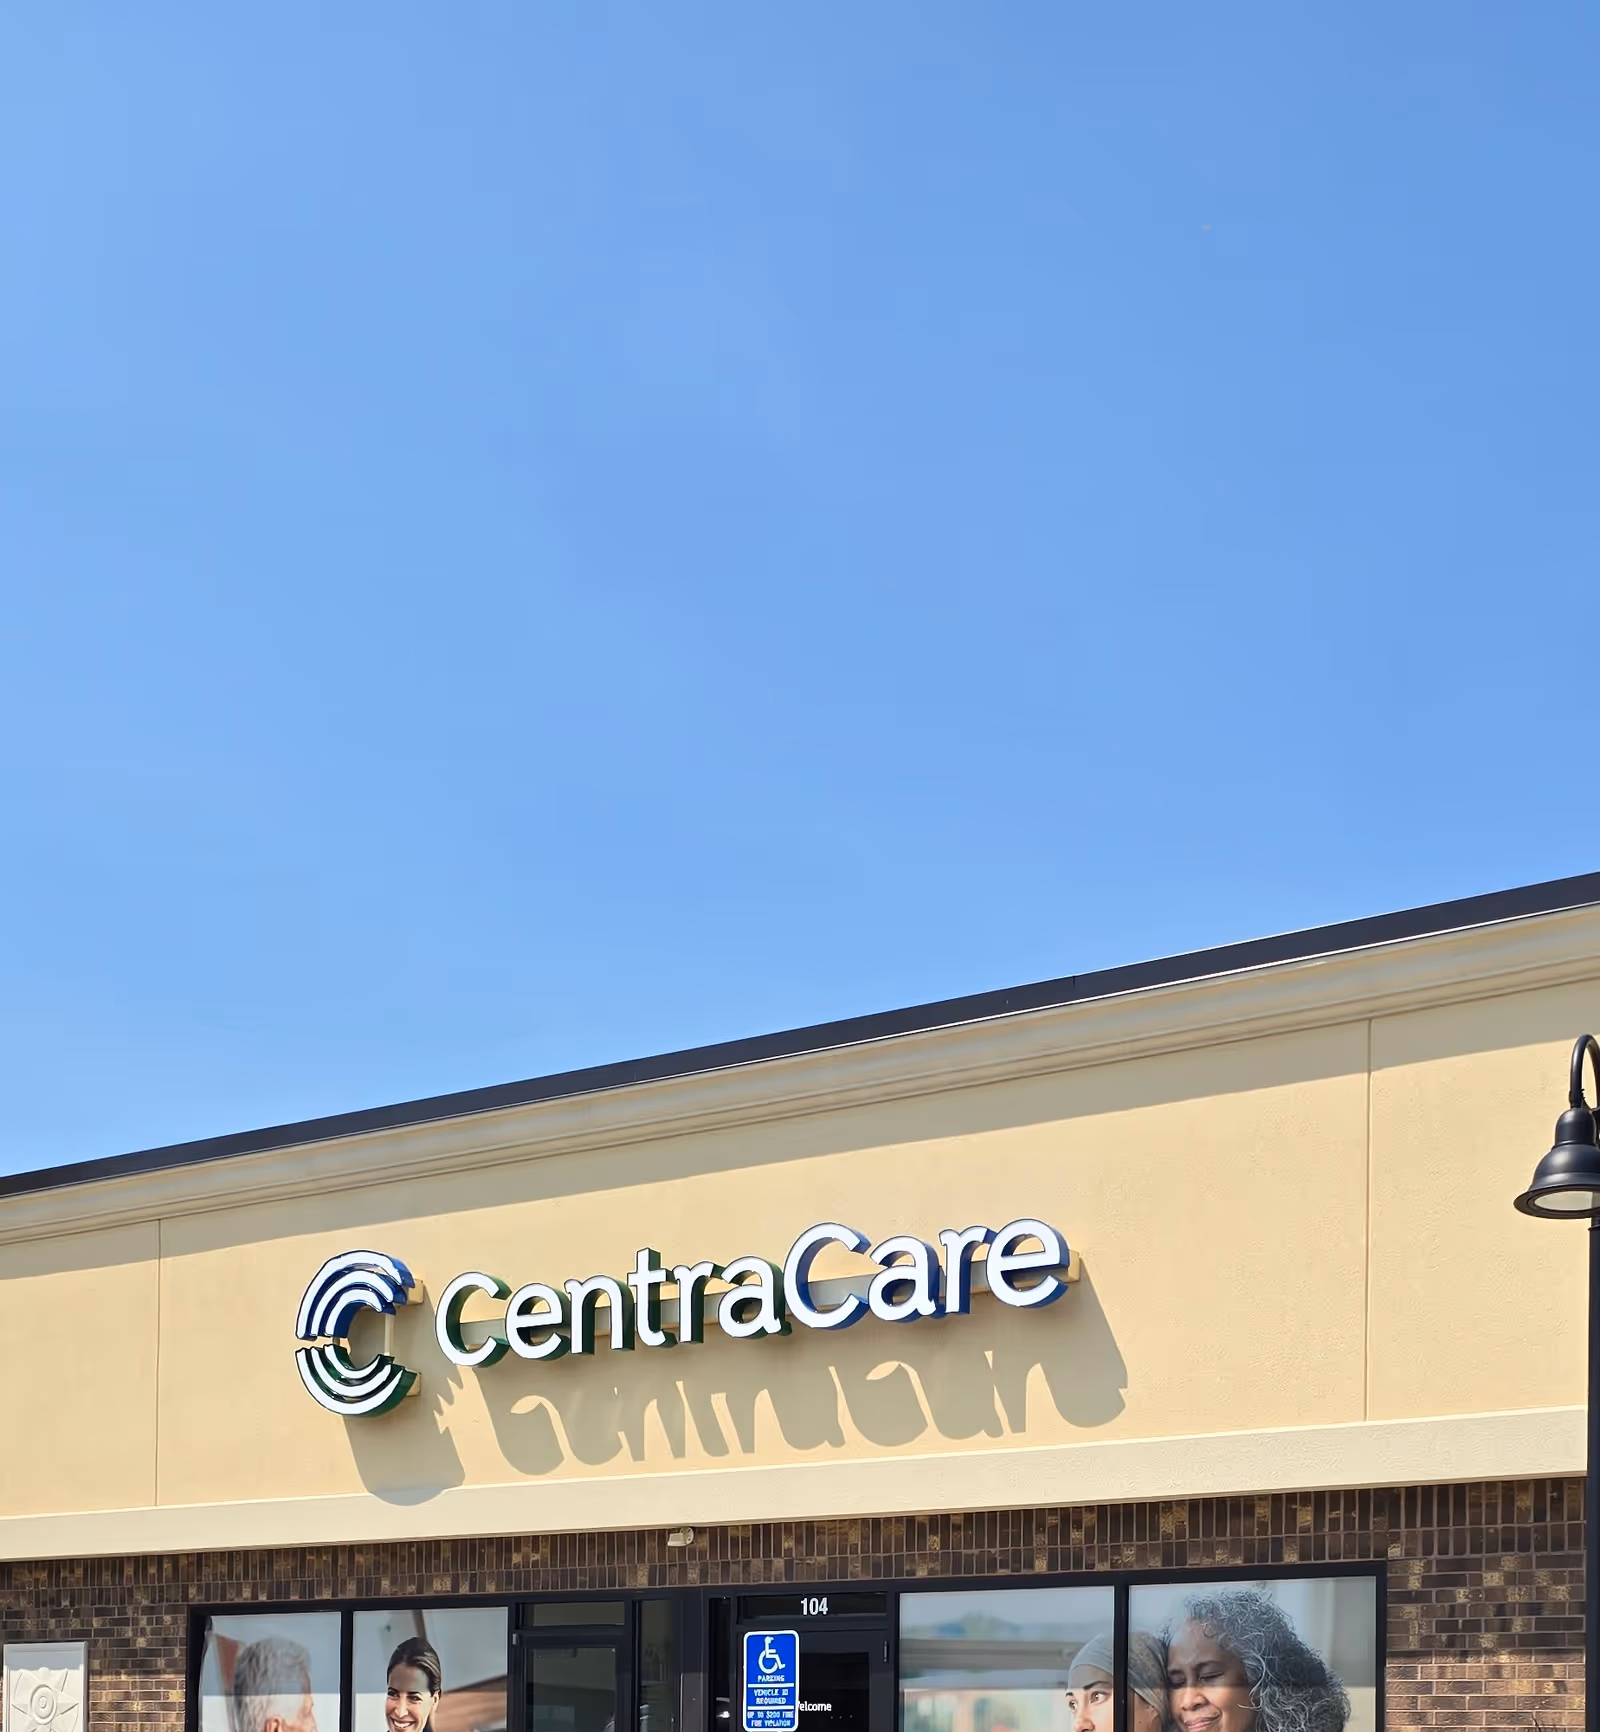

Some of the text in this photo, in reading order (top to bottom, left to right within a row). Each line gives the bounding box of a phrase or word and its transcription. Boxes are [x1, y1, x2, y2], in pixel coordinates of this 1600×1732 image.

[434, 1217, 1070, 1368] CentraCare
[800, 1597, 829, 1615] 104
[756, 1697, 787, 1705] REQUIRED
[766, 1711, 780, 1719] $200
[764, 1719, 791, 1727] VIOLATION
